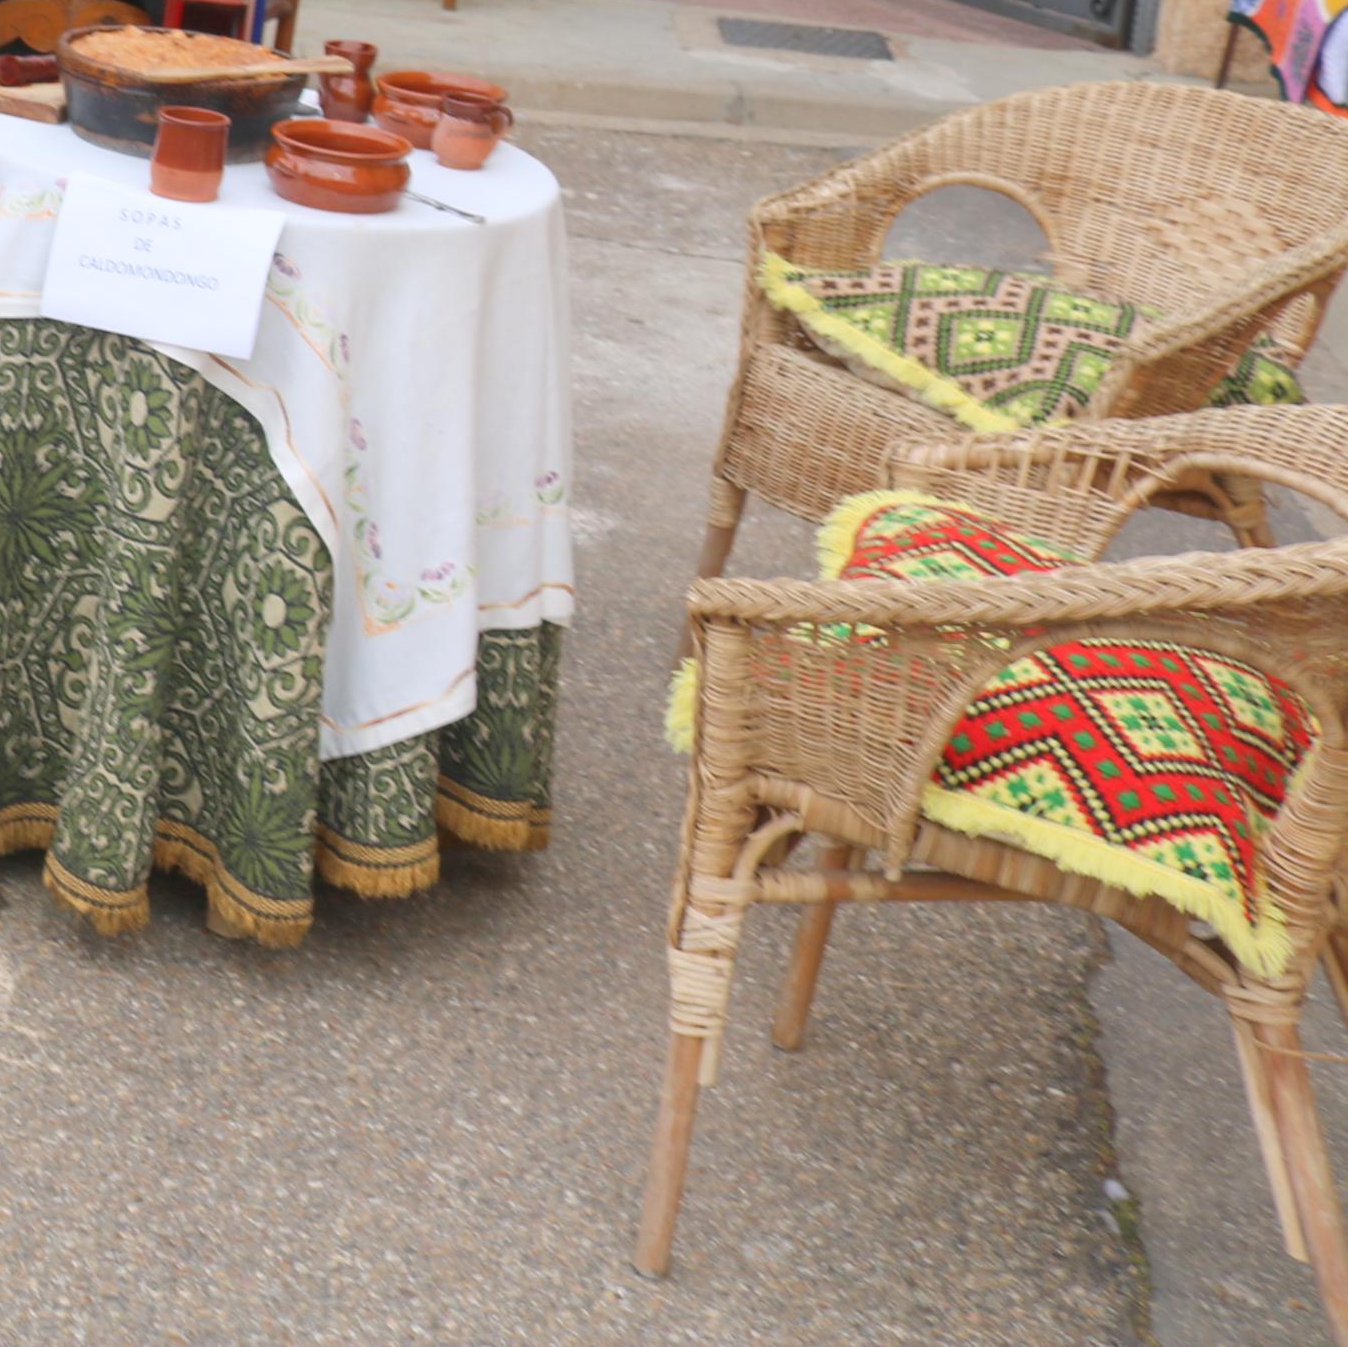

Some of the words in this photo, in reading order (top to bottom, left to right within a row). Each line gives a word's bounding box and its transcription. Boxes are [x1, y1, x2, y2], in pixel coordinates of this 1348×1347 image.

[119, 208, 182, 230] SOPAS
[134, 237, 153, 252] DE
[79, 255, 219, 291] CALDOMONDONGO
